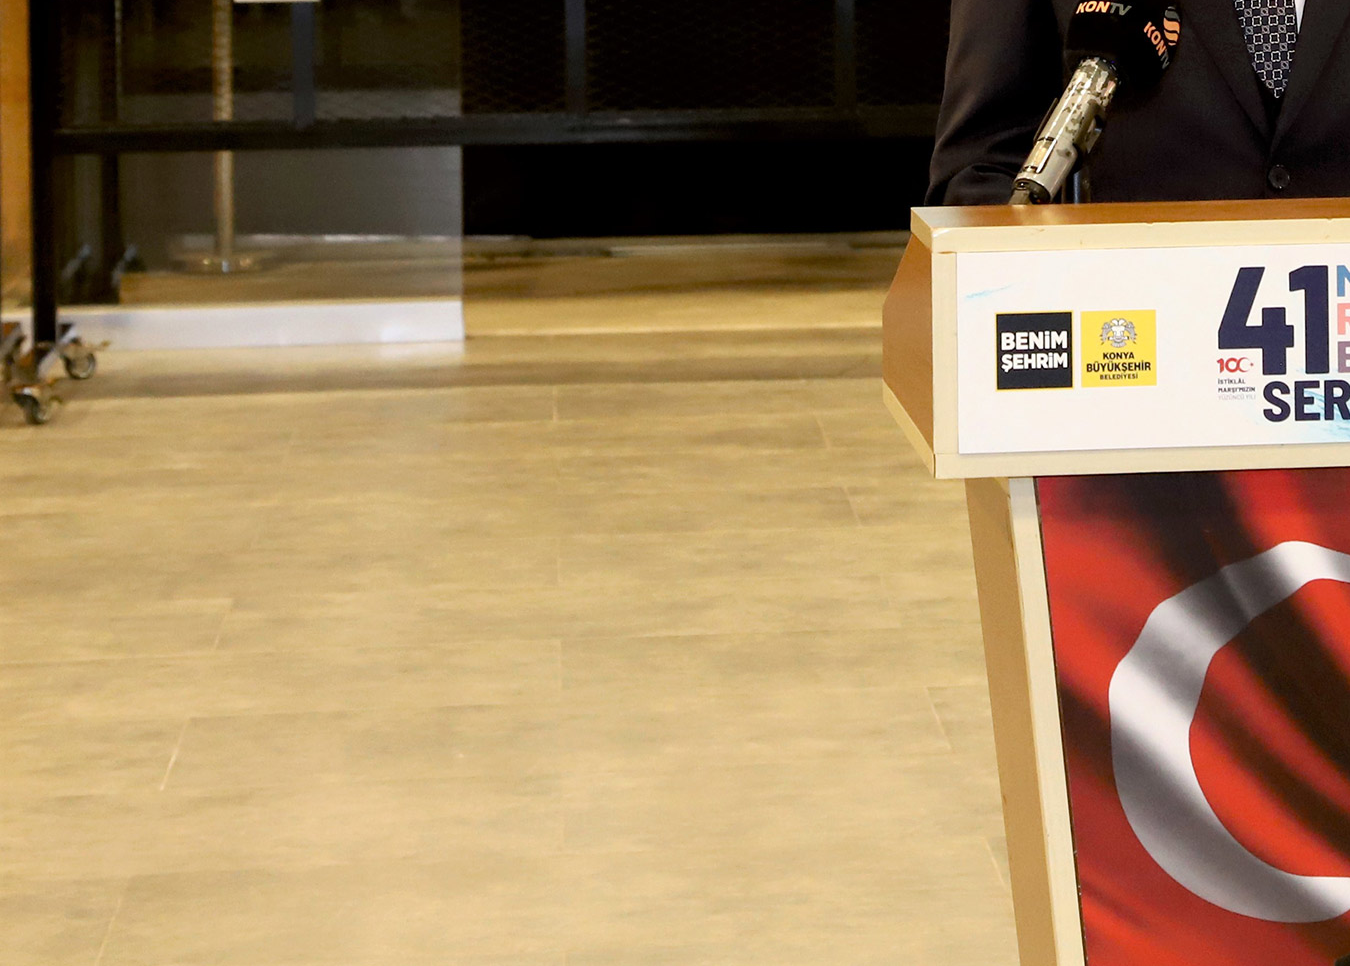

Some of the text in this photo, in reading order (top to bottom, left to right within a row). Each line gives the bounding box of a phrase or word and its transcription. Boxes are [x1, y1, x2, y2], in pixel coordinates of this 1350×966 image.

[1075, 0, 1132, 16] KONTV
[1143, 21, 1170, 70] KONTV
[1218, 265, 1330, 375] 41
[1102, 351, 1135, 360] KONYA
[1086, 359, 1152, 373] BÜYÜKŞEHİR
